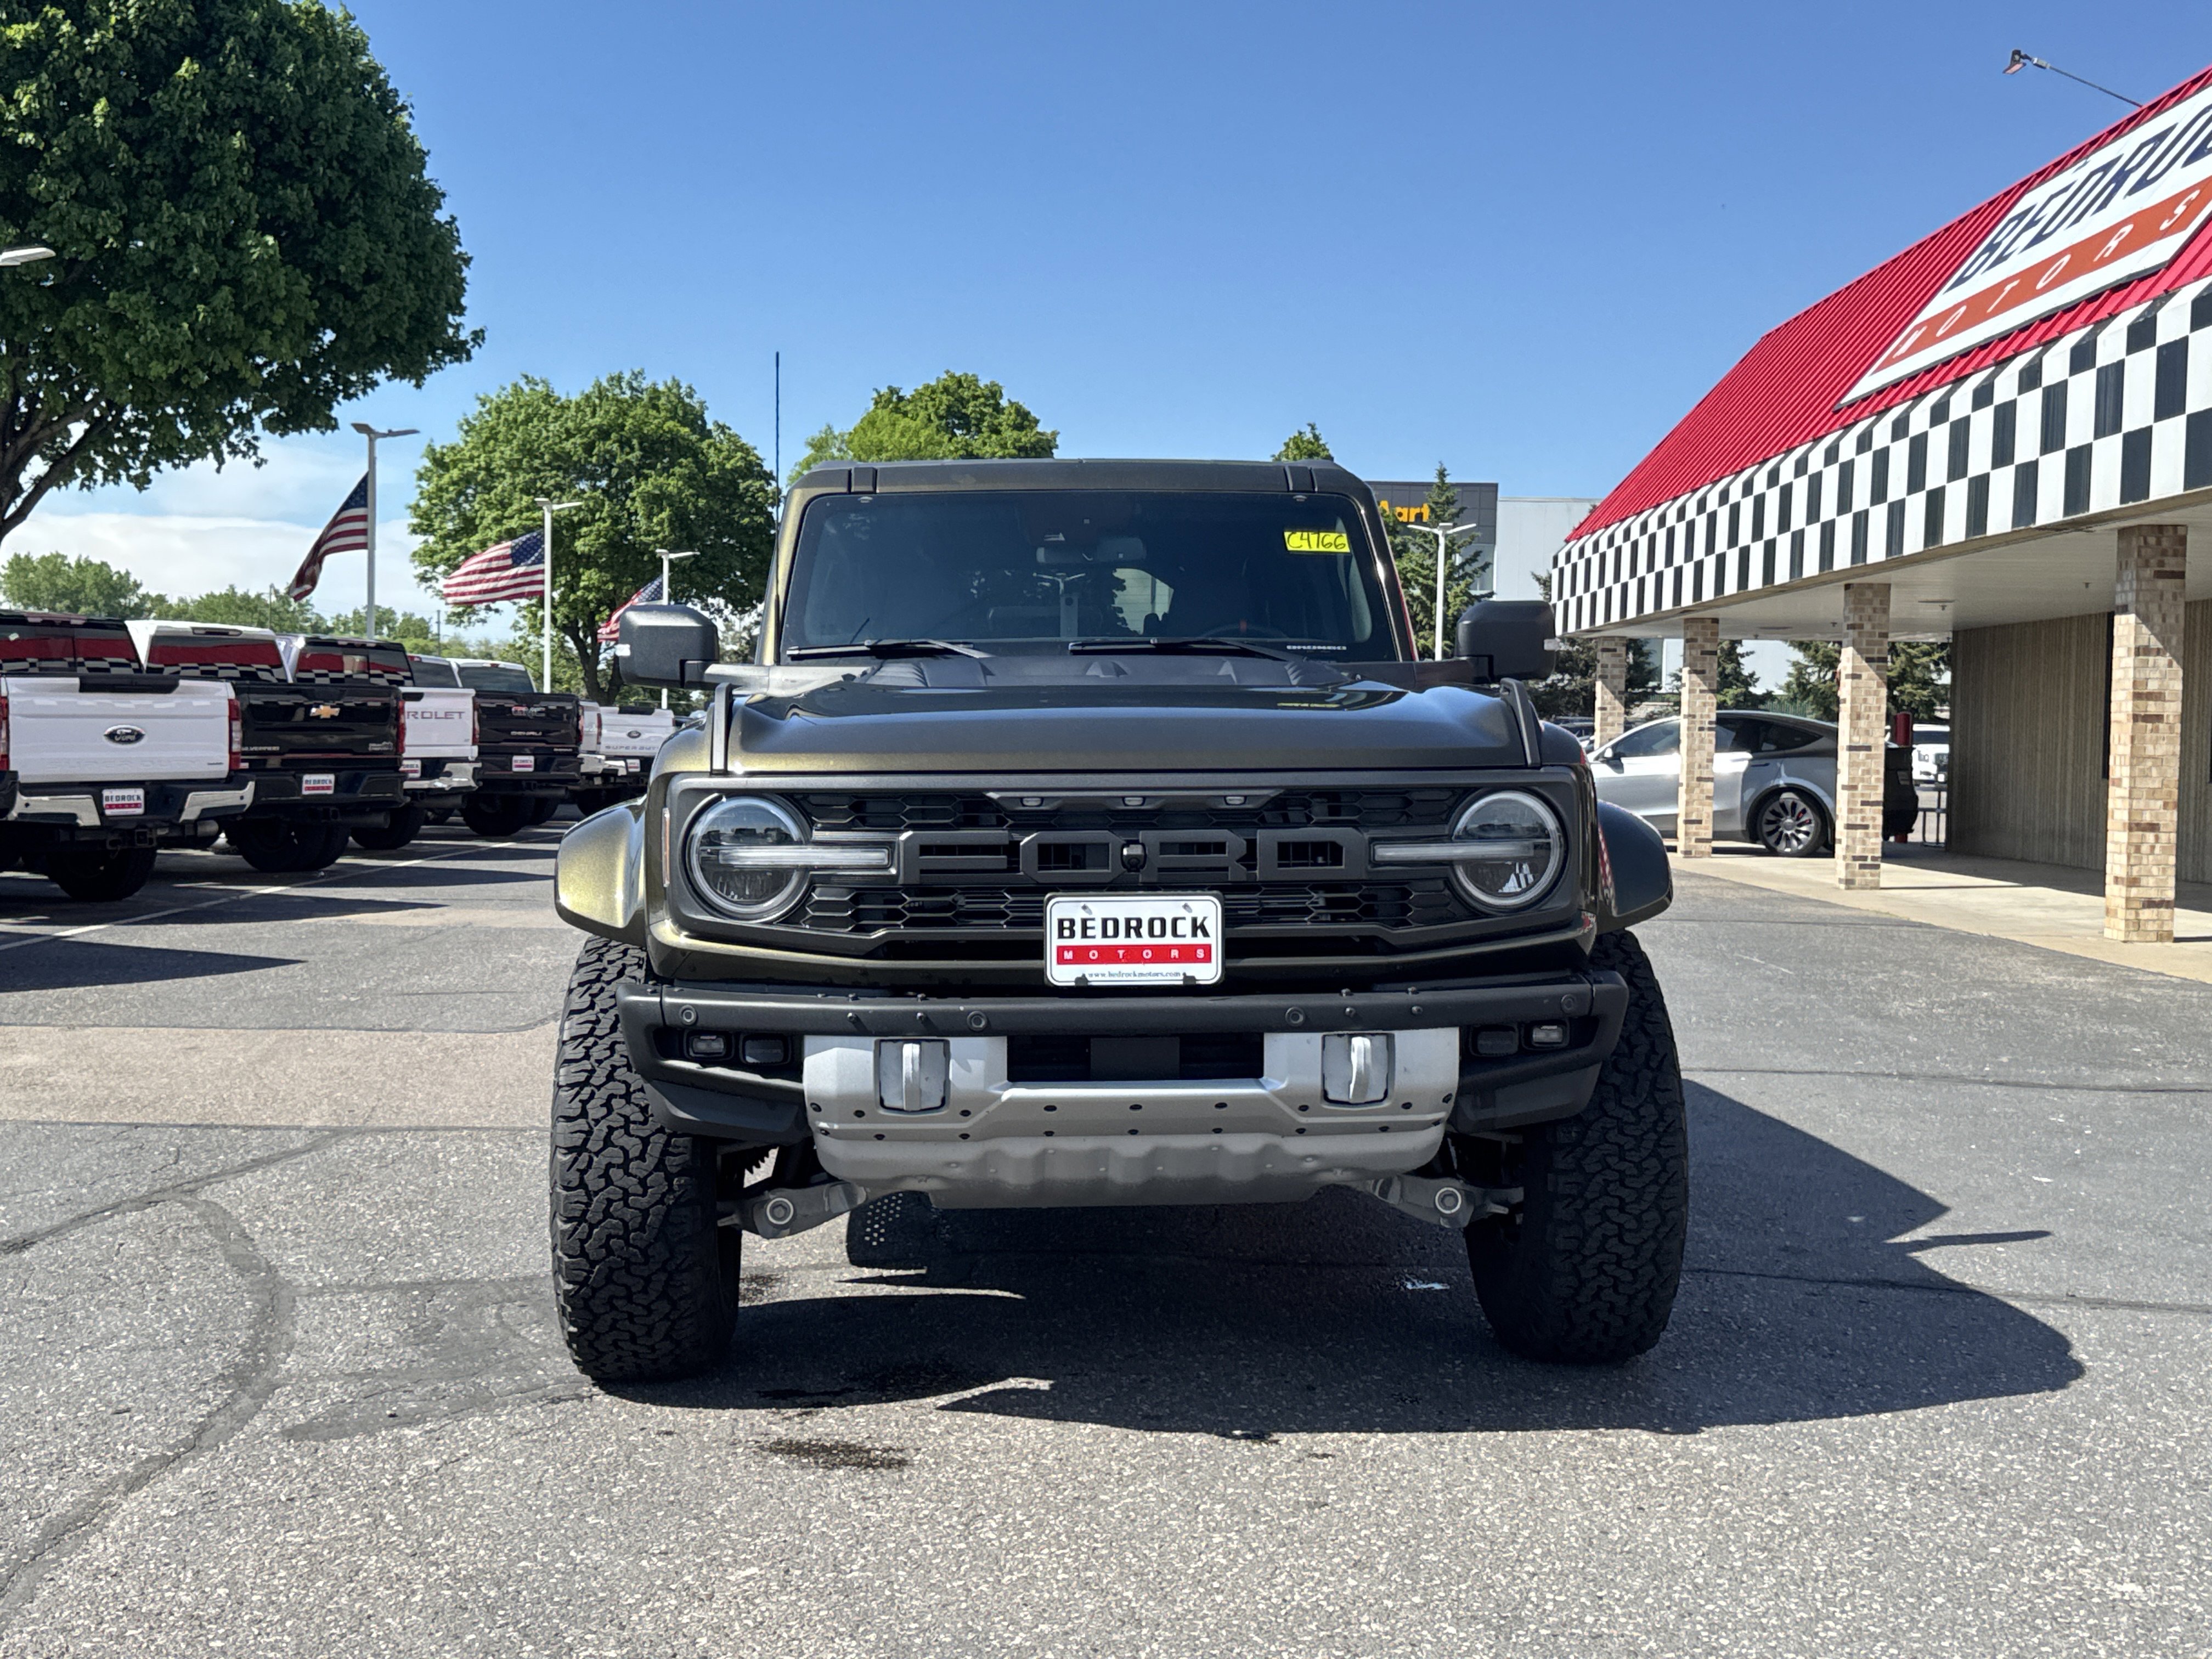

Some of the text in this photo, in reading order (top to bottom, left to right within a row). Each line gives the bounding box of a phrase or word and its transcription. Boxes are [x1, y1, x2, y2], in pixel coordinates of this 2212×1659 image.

[1892, 189, 2200, 359] MOTORS
[1287, 532, 1346, 549] C4766
[899, 829, 1370, 884] FORD
[1057, 916, 1211, 940] BEDROCK
[1063, 948, 1205, 960] MOTORS
